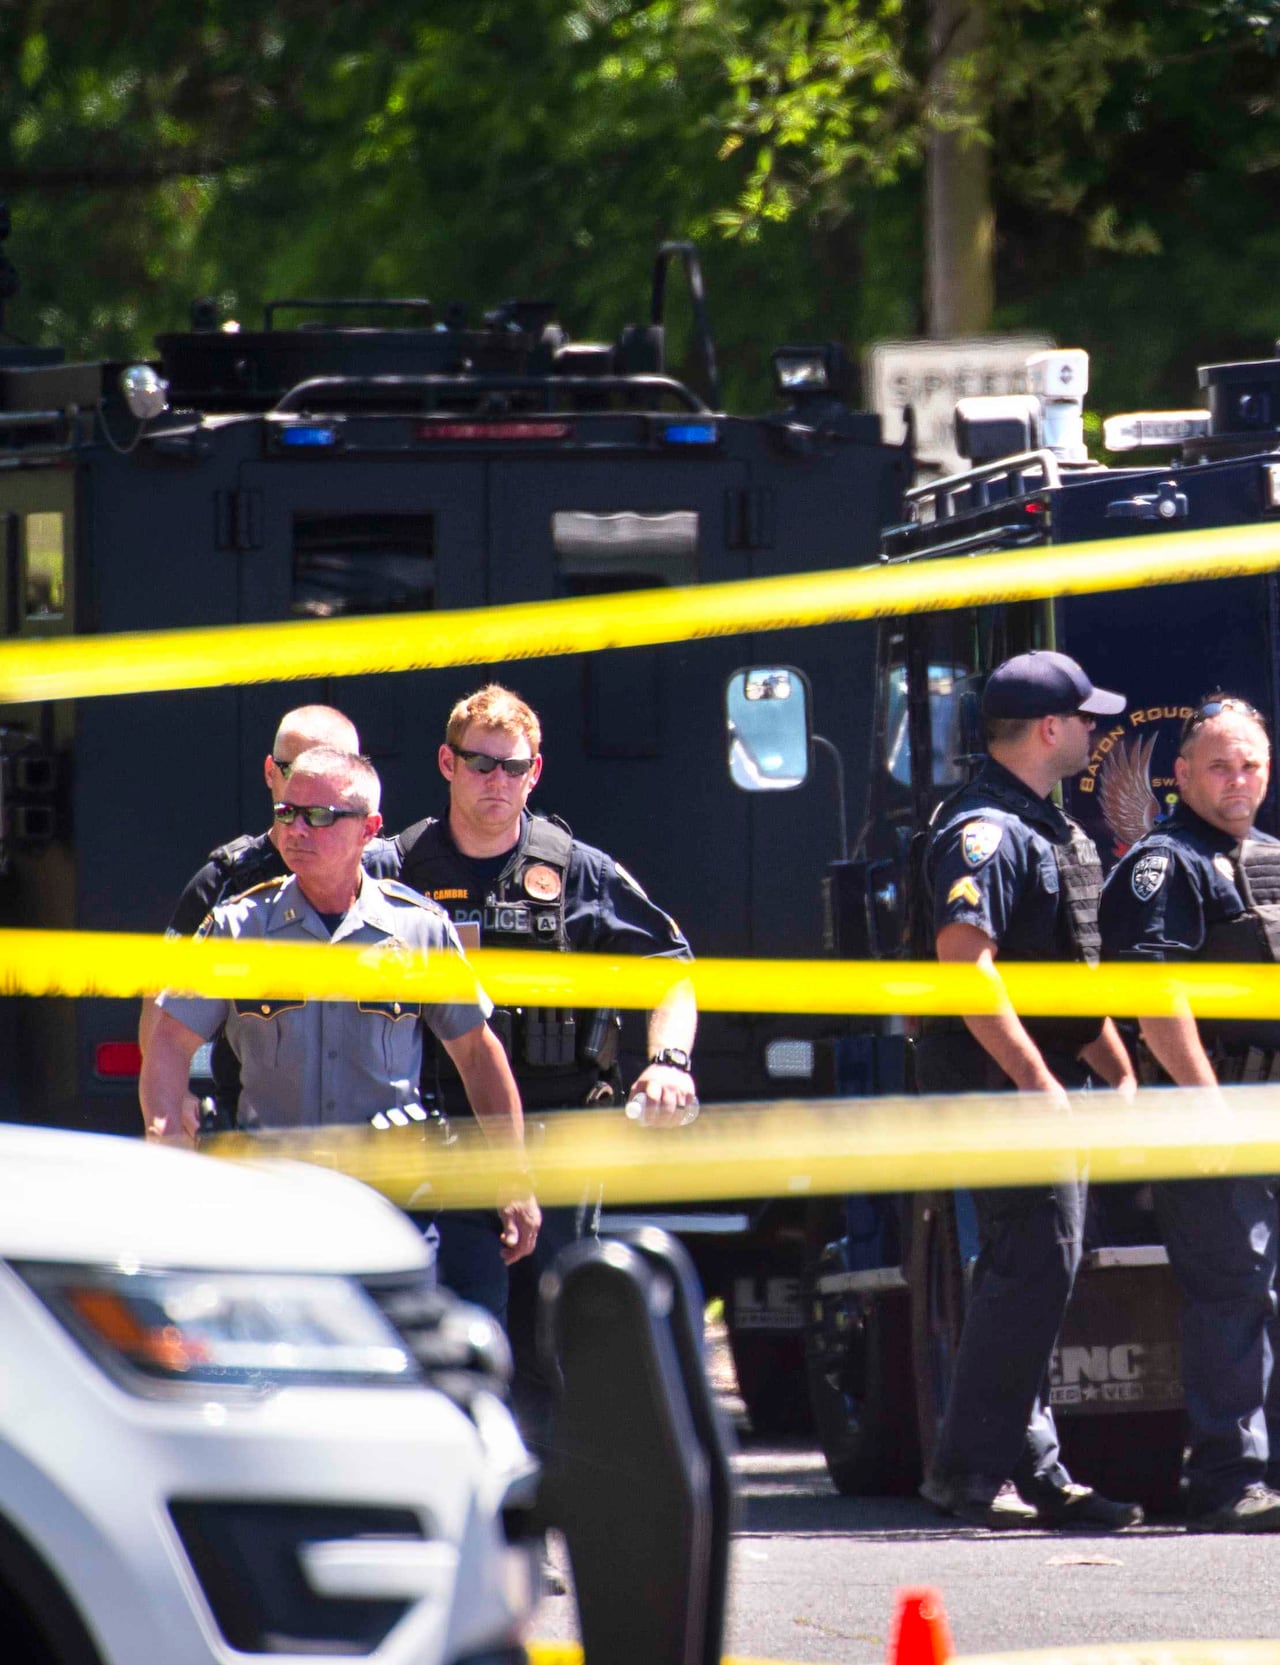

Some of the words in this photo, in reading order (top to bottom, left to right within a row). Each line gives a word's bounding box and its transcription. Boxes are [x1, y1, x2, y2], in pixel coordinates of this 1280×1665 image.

[1079, 725, 1126, 793] BATON
[1129, 706, 1193, 726] ROUG
[1152, 778, 1180, 788] SW
[433, 888, 469, 900] CAMBRE
[455, 908, 528, 930] POLICE
